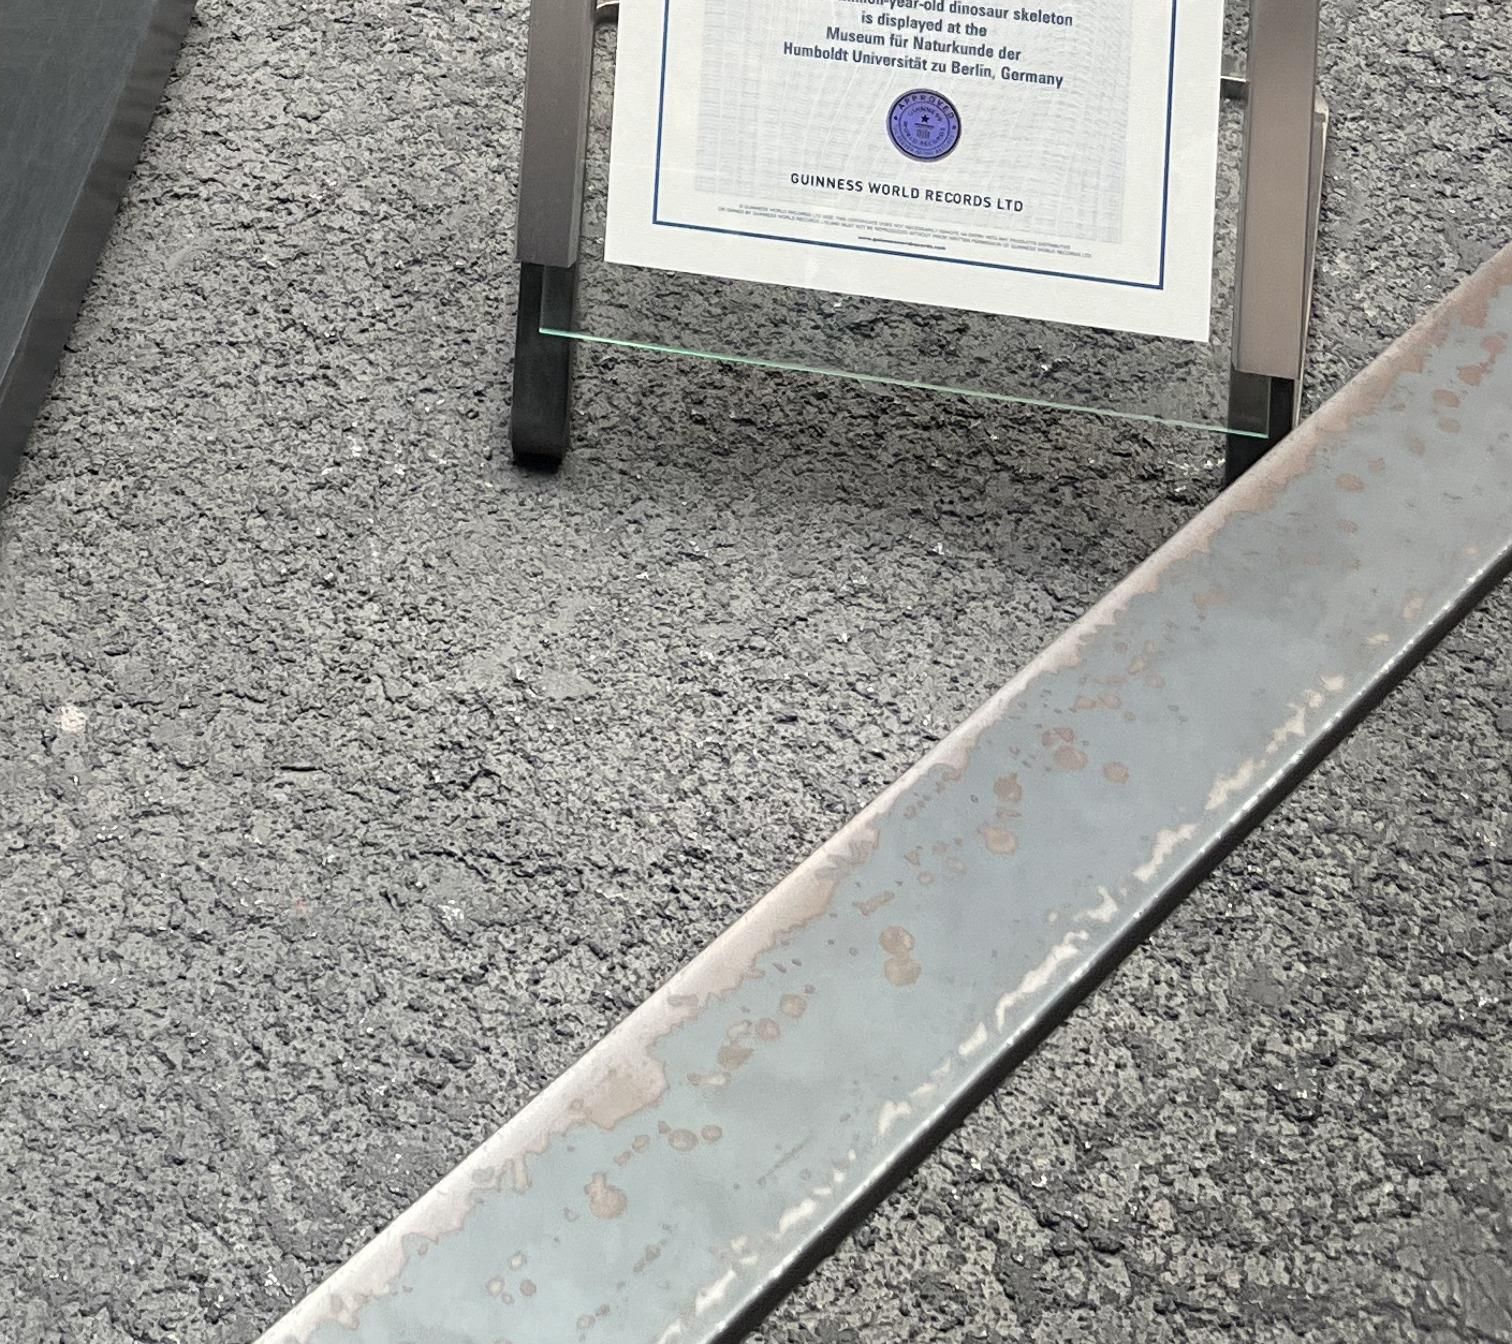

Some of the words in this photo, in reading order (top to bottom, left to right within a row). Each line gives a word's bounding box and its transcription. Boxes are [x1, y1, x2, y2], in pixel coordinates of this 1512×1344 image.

[861, 9, 873, 24] is
[877, 12, 942, 33] displayed
[946, 21, 961, 34] at
[964, 22, 987, 36] the
[949, 0, 1008, 19] dinosaur
[1013, 7, 1072, 26] skeleton
[826, 26, 884, 45] Museum
[889, 32, 908, 48] für
[913, 35, 993, 57] Naturkunde
[998, 45, 1021, 60] der
[783, 41, 848, 61] Humboldt
[852, 49, 927, 70] Universität
[930, 61, 946, 72] zu
[951, 60, 995, 79] Berlin,
[1000, 66, 1063, 89] Germany
[790, 172, 862, 192] GUINNESS
[868, 181, 919, 198] WORLD
[925, 189, 991, 208] RECORDS
[996, 197, 1023, 212] LTD
